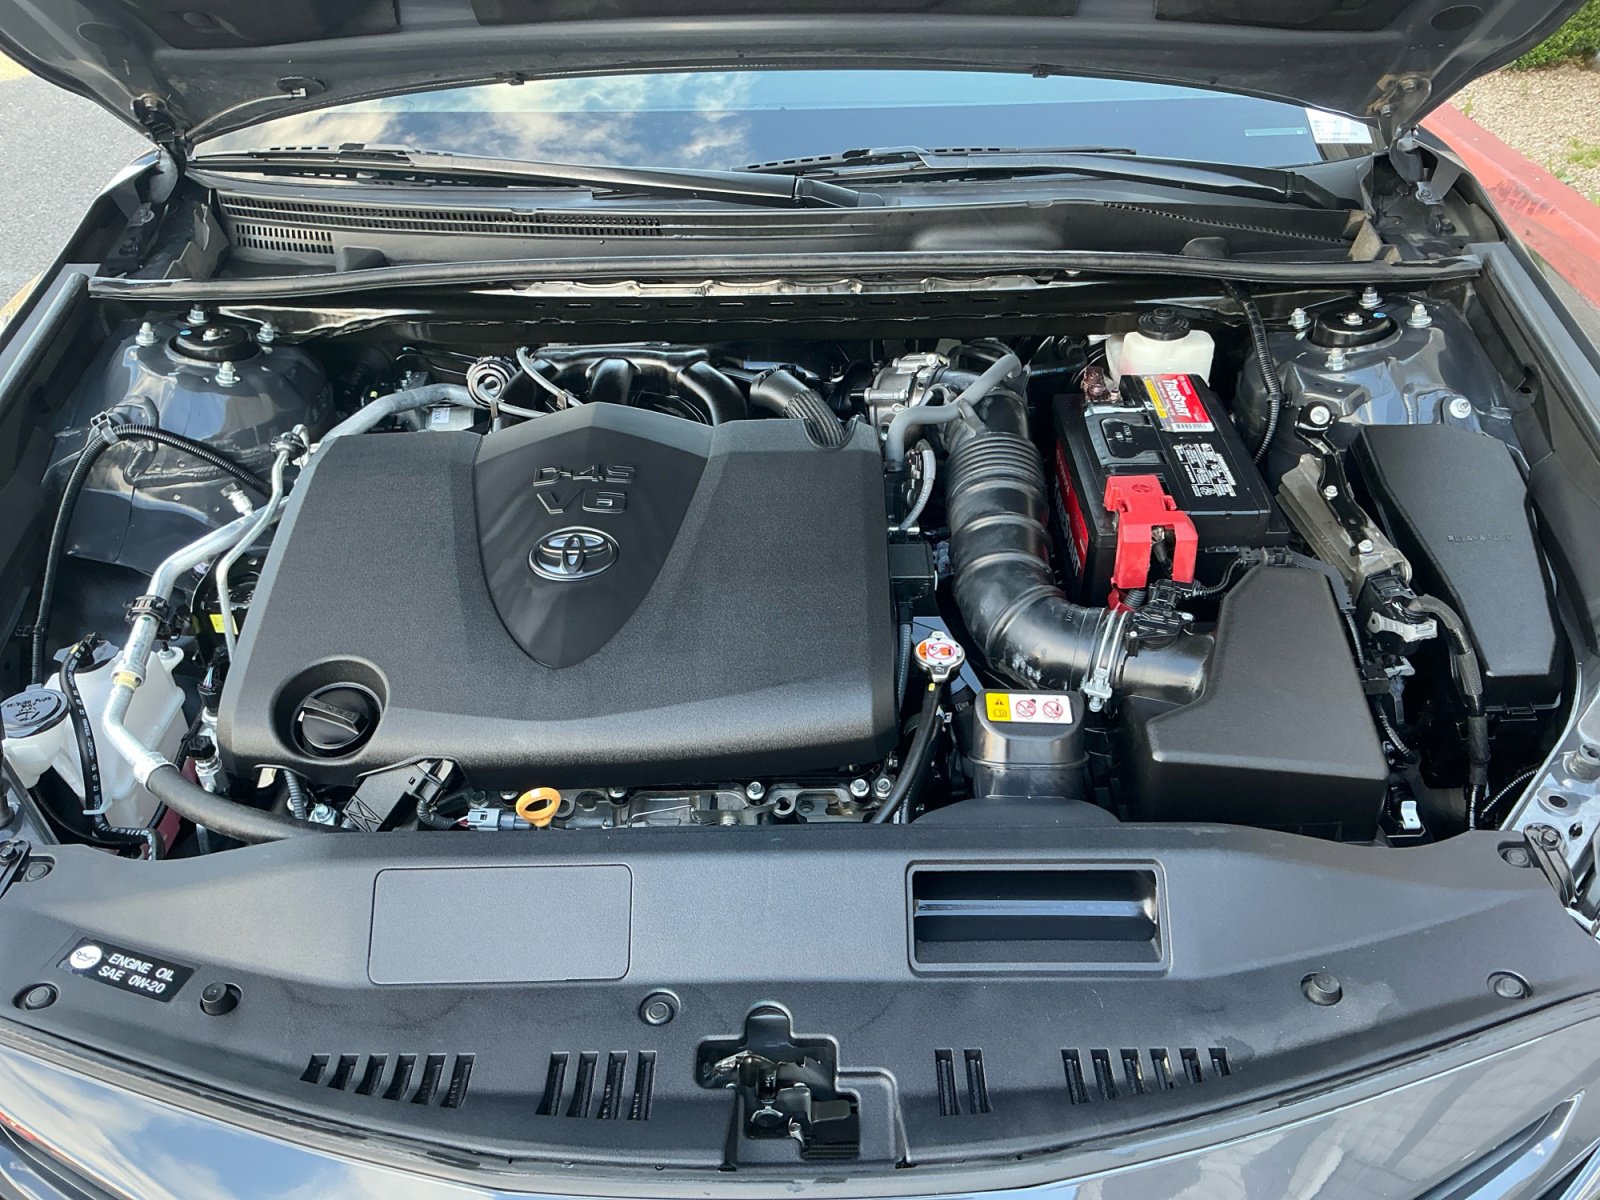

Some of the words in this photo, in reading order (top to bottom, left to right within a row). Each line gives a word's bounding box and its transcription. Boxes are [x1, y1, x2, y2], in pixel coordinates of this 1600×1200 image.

[533, 465, 636, 487] D-4S
[536, 490, 626, 514] V6
[98, 965, 126, 981] SAE
[127, 974, 166, 994] 0W-20
[108, 953, 153, 974] ENGINE
[155, 967, 176, 982] OIL
